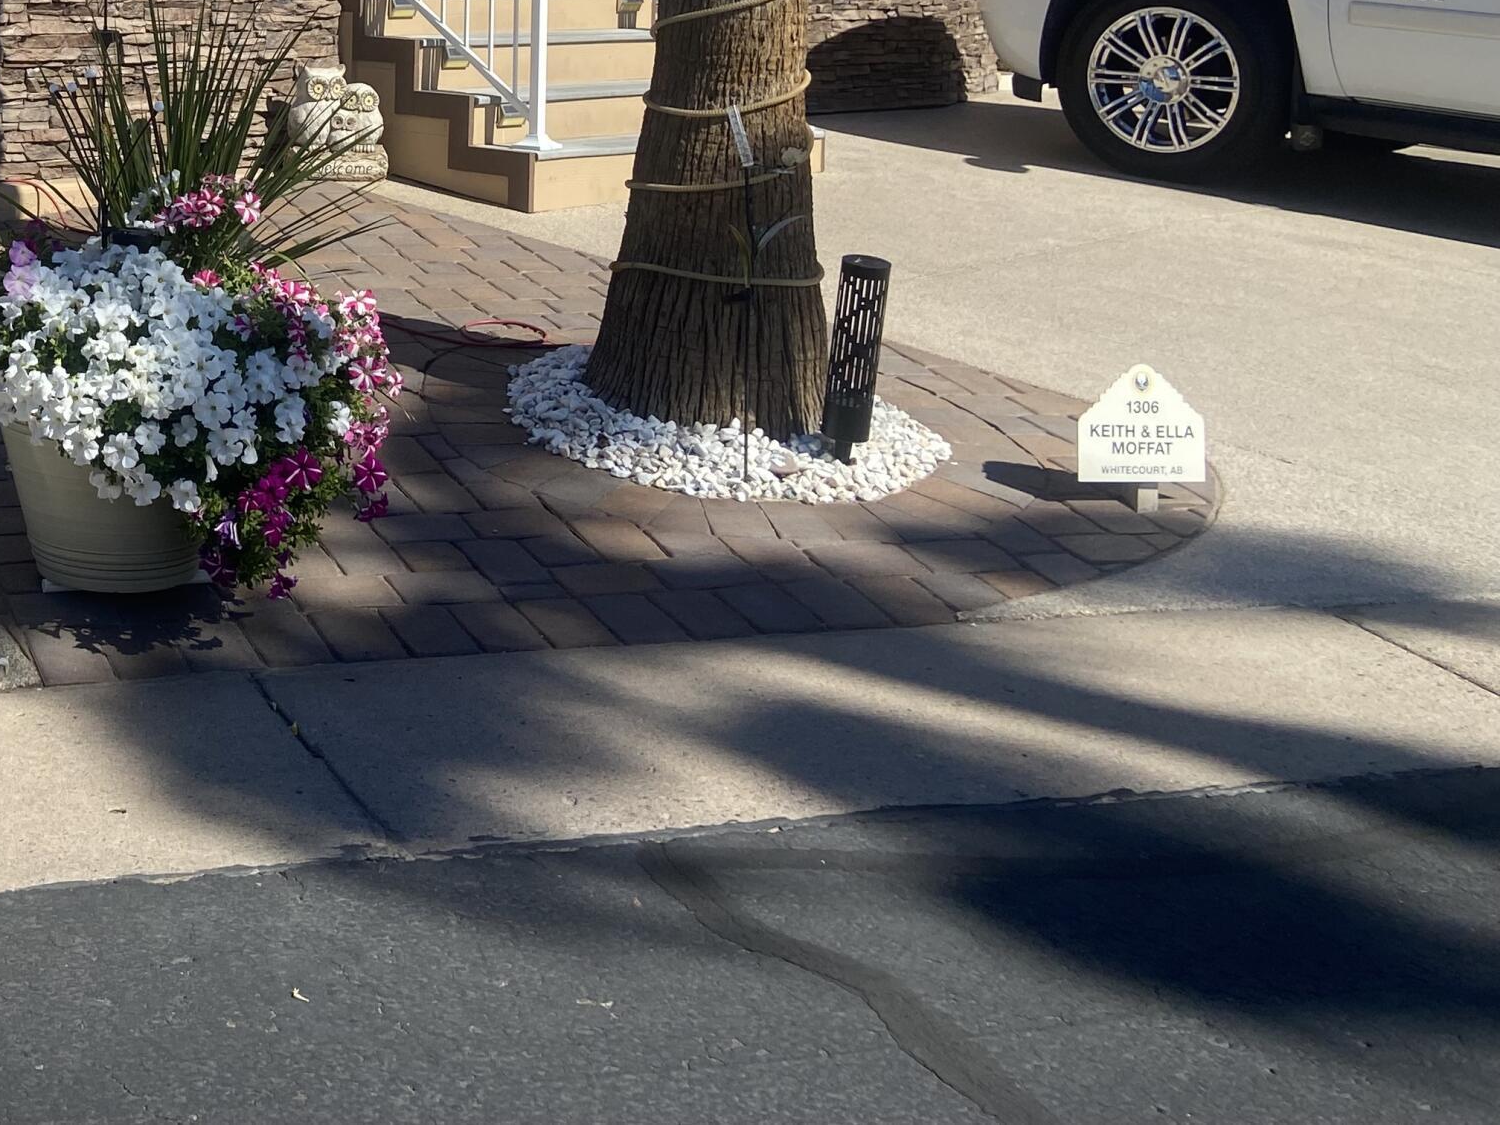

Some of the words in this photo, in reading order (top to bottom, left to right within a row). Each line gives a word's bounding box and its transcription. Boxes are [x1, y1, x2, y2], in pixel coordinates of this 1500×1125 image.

[1126, 400, 1160, 414] 1306
[1089, 424, 1136, 438] KEITH
[1141, 425, 1152, 439] &
[1156, 425, 1195, 439] ELLA
[1111, 441, 1173, 455] MOFFAT
[1101, 465, 1168, 476] WHITECOURT,
[1170, 466, 1183, 475] AB
